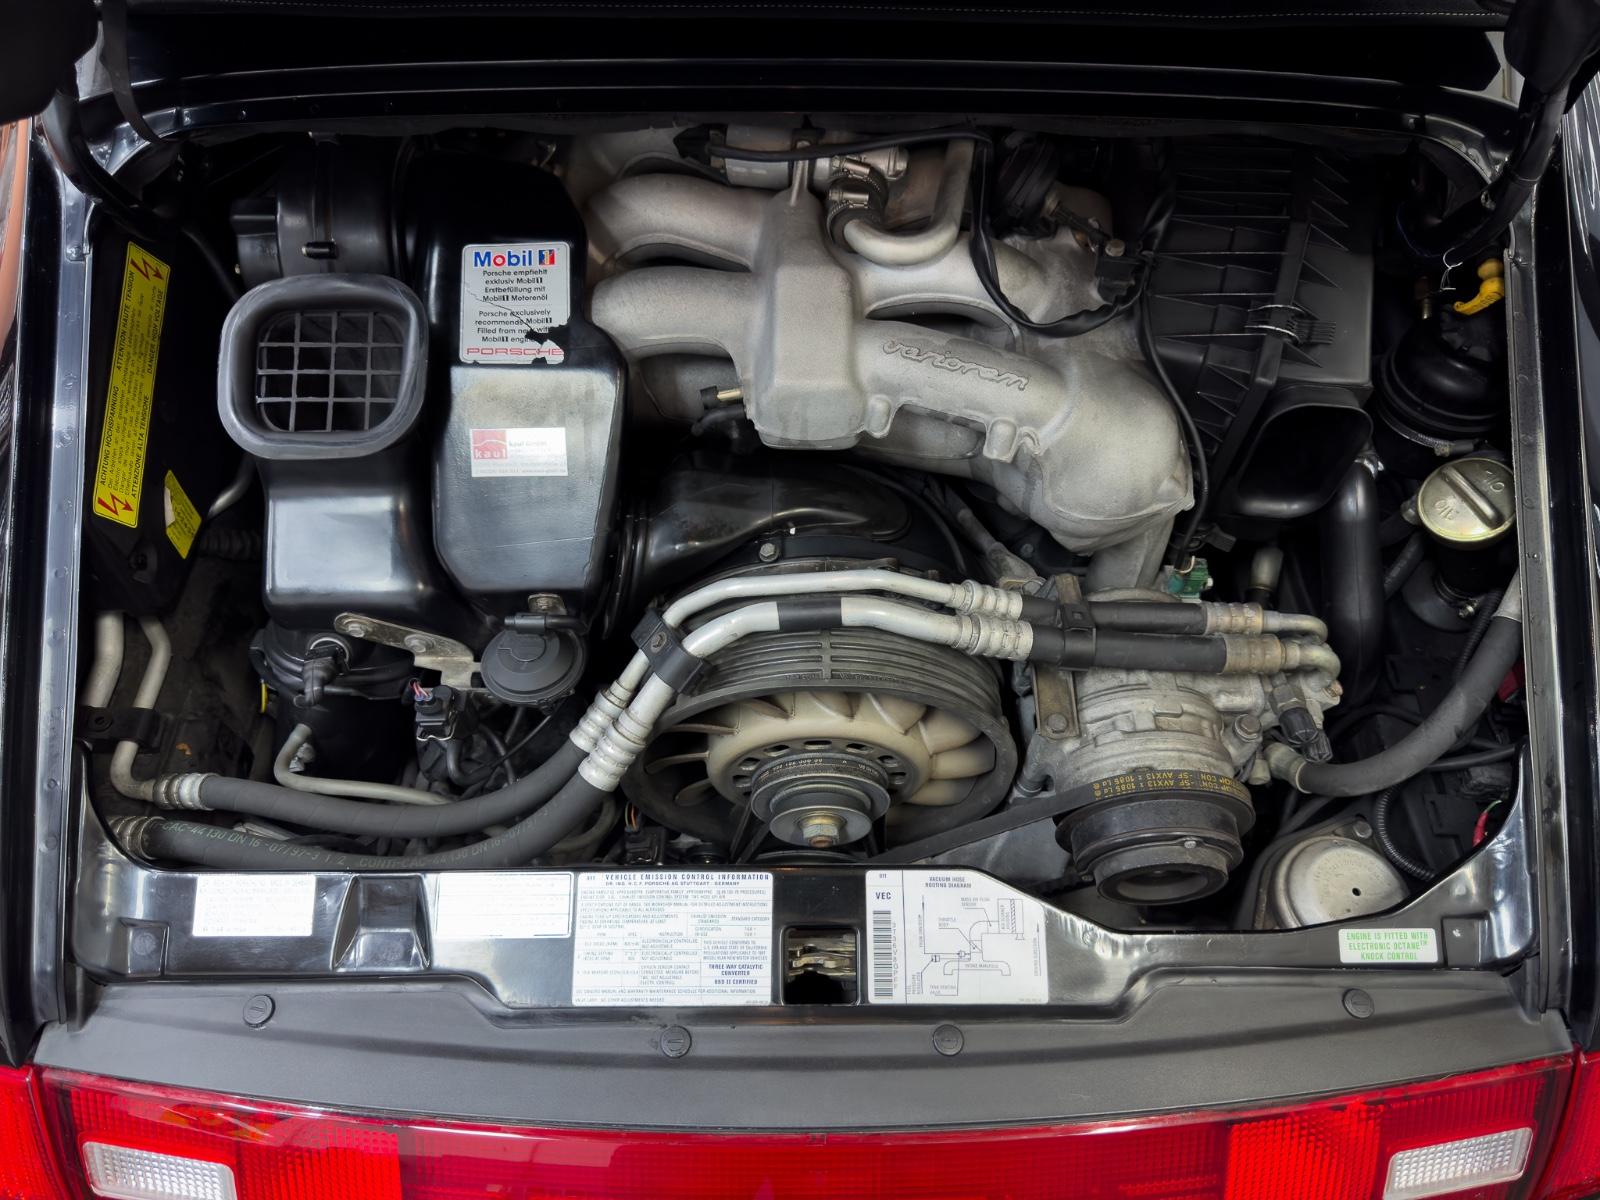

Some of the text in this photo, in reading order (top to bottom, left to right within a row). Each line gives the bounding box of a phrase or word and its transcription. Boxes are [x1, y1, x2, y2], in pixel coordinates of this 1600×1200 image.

[474, 250, 532, 268] Mobil
[514, 269, 548, 277] empfiehlt
[115, 270, 135, 370] ATTENTION HAUTE TENSION
[146, 343, 157, 374] DANGER
[153, 289, 164, 322] VOLTAGE
[467, 348, 564, 356] PORSCHE
[99, 386, 120, 485] ACHTUNG HOCHSPANNUNG
[129, 395, 150, 498] ATTENZIONE ALTA TENSIONE
[475, 448, 506, 458] kaul
[1146, 772, 1173, 780] AVX13
[1148, 779, 1174, 788] AVX13
[227, 832, 246, 845] DN
[249, 836, 261, 847] 16
[876, 892, 892, 900] VEC
[1347, 932, 1372, 940] ENGINE
[1375, 932, 1382, 940] IS
[1411, 931, 1428, 939] WITH
[1360, 952, 1418, 960] KNOCK CONTROL
